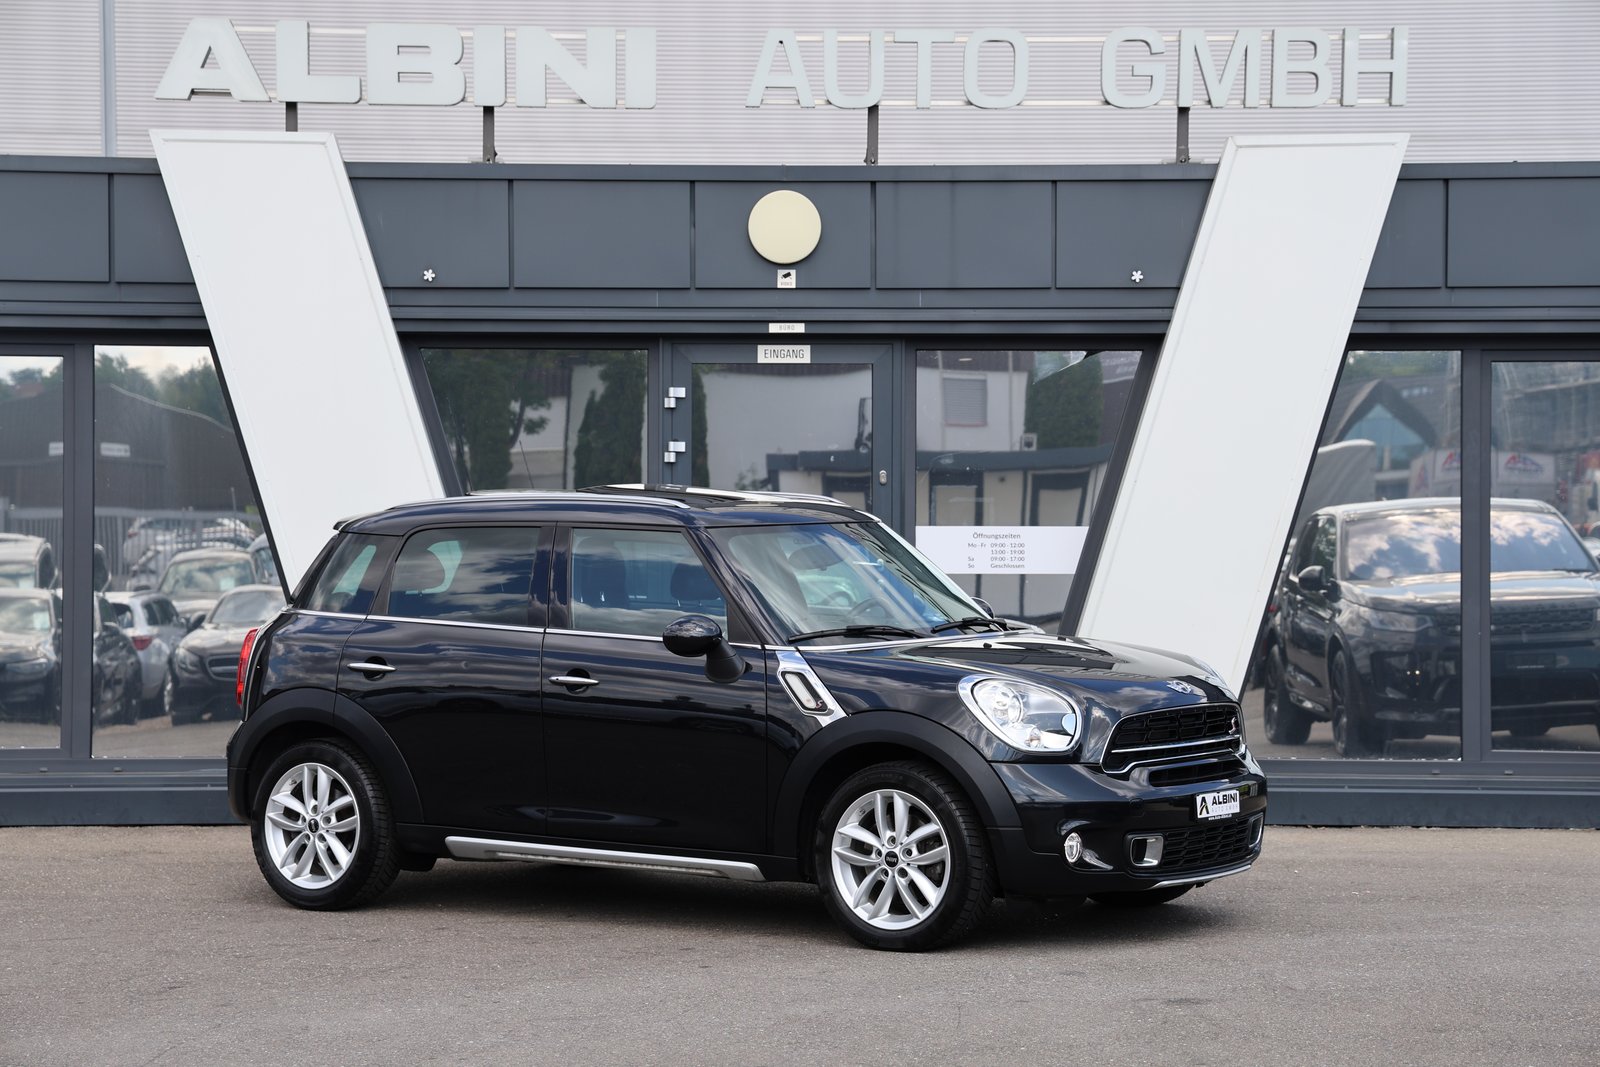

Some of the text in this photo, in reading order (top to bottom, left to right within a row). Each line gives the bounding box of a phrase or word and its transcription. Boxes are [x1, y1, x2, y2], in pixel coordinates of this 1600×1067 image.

[154, 17, 1409, 110] ALBINI AUTO GMBH
[764, 348, 805, 359] EINGANG
[972, 532, 1021, 540] Öffnungszeiten
[1211, 793, 1238, 806] ALBINI
